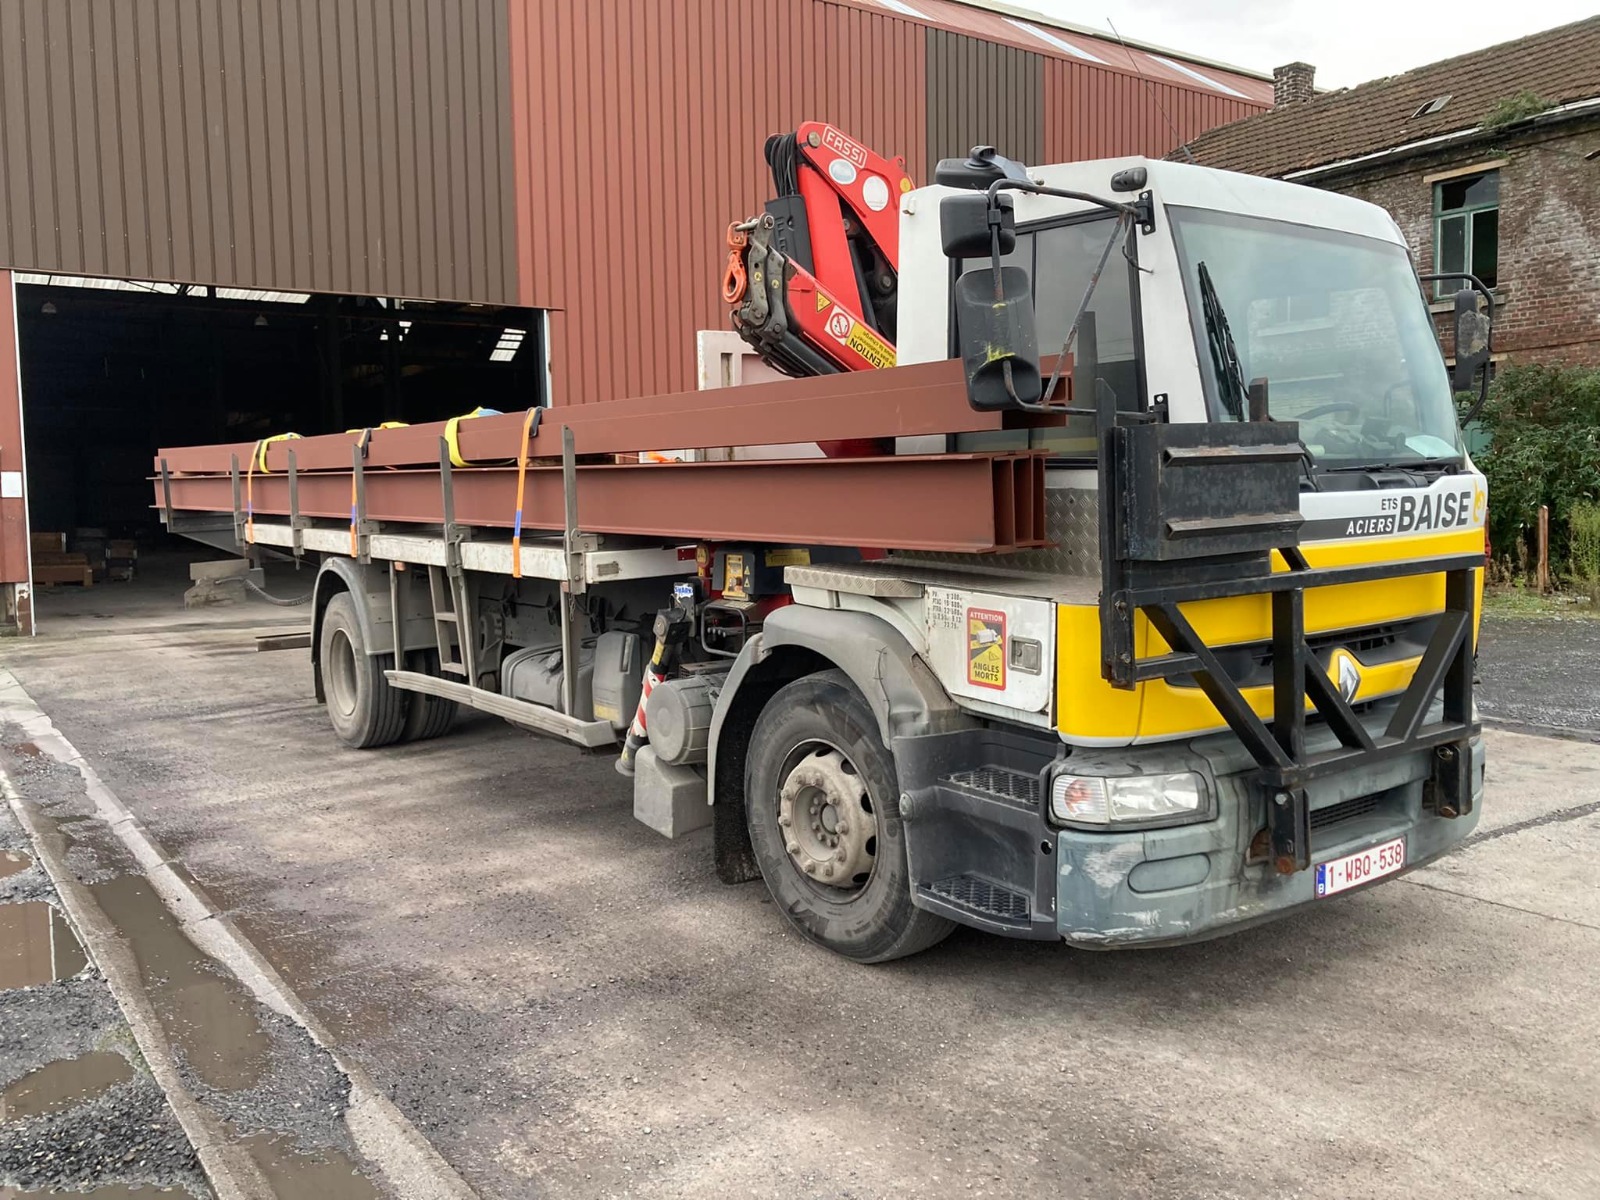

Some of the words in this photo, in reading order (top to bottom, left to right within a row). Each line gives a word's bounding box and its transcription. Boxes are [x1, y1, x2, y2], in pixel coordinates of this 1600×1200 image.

[826, 131, 864, 163] FASSI
[849, 338, 886, 368] TENTION
[1381, 498, 1398, 510] ETS
[1397, 491, 1471, 532] BAISE
[1346, 518, 1393, 535] ACIERS
[970, 611, 1003, 622] ATTENTION
[973, 662, 1000, 674] ANGLES
[974, 670, 999, 682] MORTS
[1328, 843, 1402, 888] 1-WBQ-538
